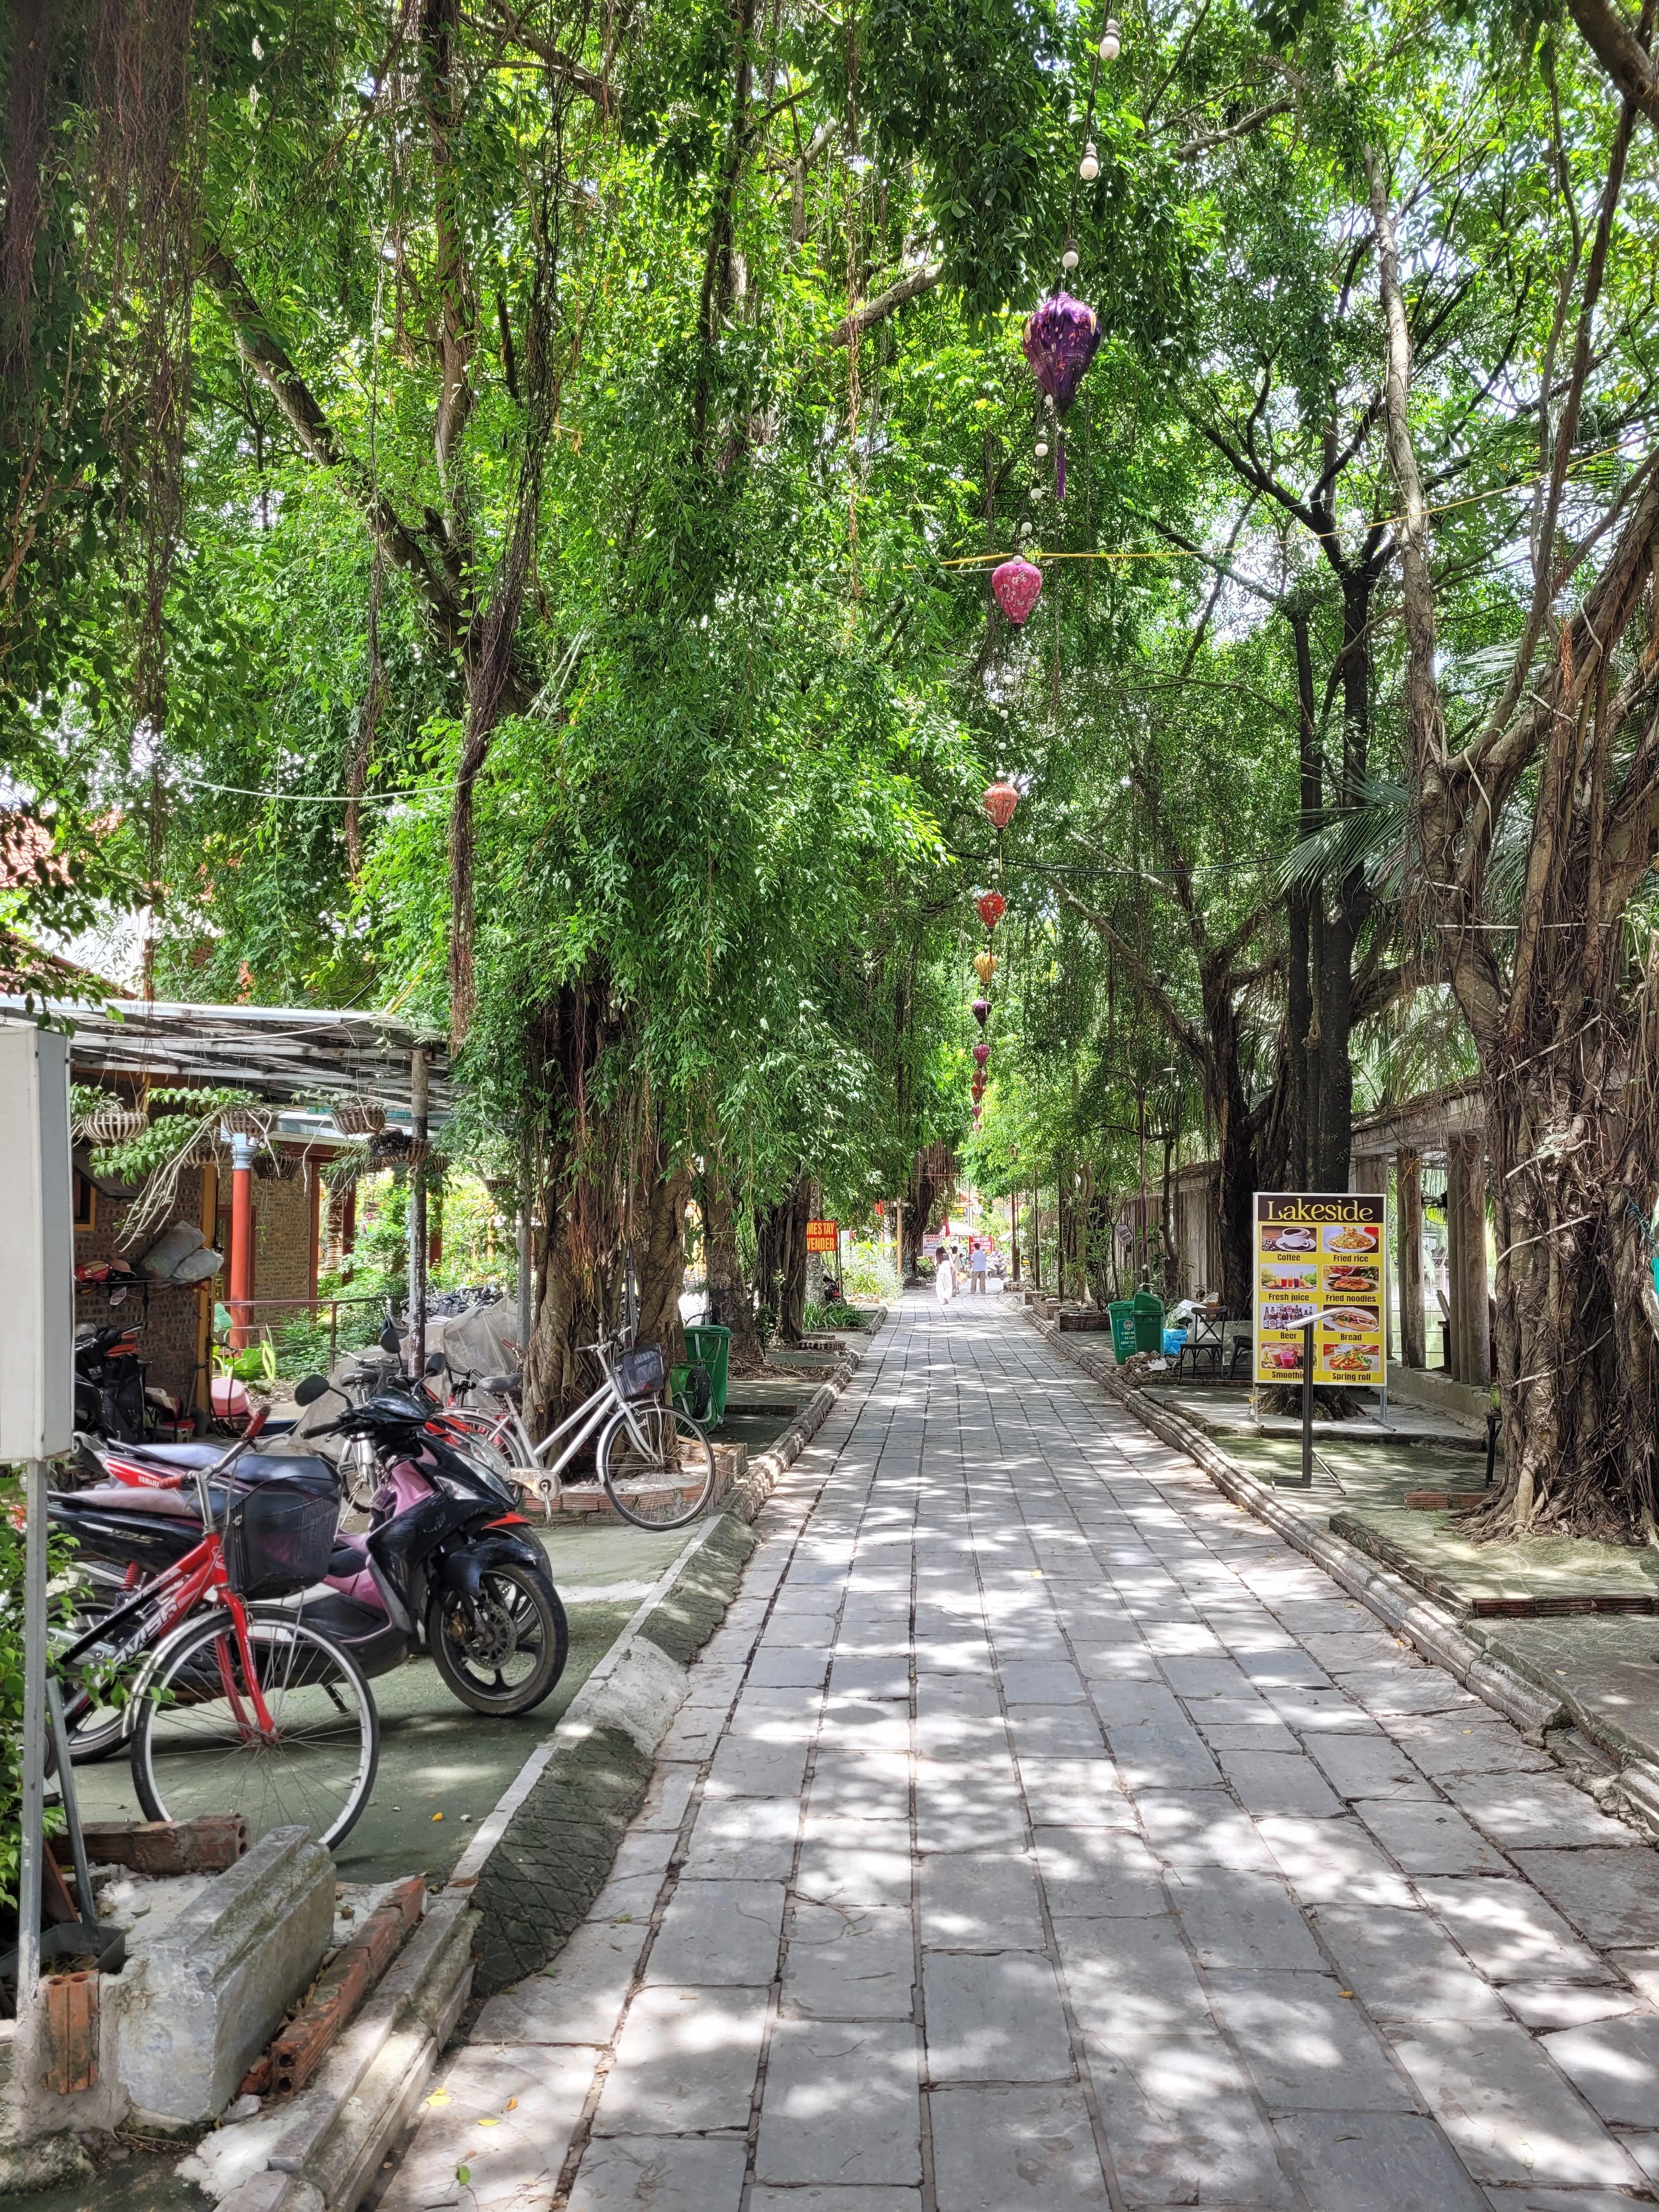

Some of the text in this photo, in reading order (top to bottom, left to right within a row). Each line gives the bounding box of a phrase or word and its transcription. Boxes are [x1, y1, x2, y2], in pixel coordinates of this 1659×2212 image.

[1267, 1198, 1373, 1221] Lakeside
[806, 1222, 834, 1235] MESTAY
[806, 1237, 834, 1250] VENDER
[1291, 1293, 1310, 1302] juice
[1272, 1371, 1304, 1379] Smoothi
[1332, 1373, 1356, 1381] Spring
